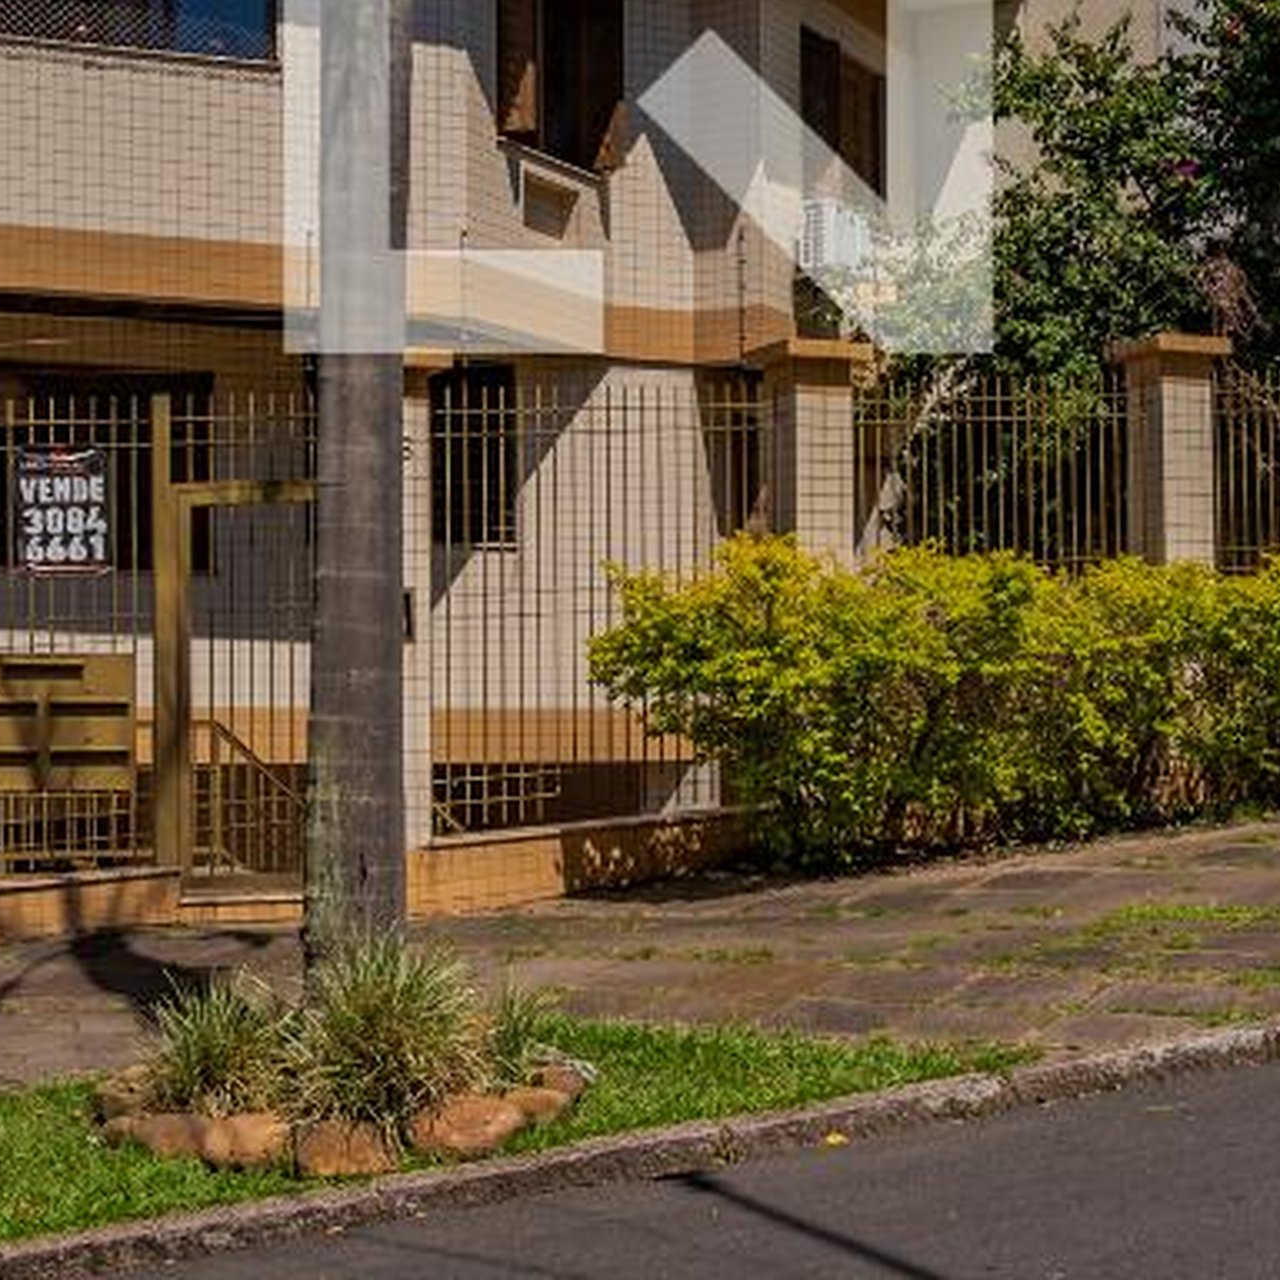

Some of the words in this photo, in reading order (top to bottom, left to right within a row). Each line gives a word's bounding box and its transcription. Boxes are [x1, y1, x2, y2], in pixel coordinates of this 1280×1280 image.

[20, 476, 104, 502] VENDE
[22, 506, 107, 534] 3084
[25, 536, 104, 561] 6661
